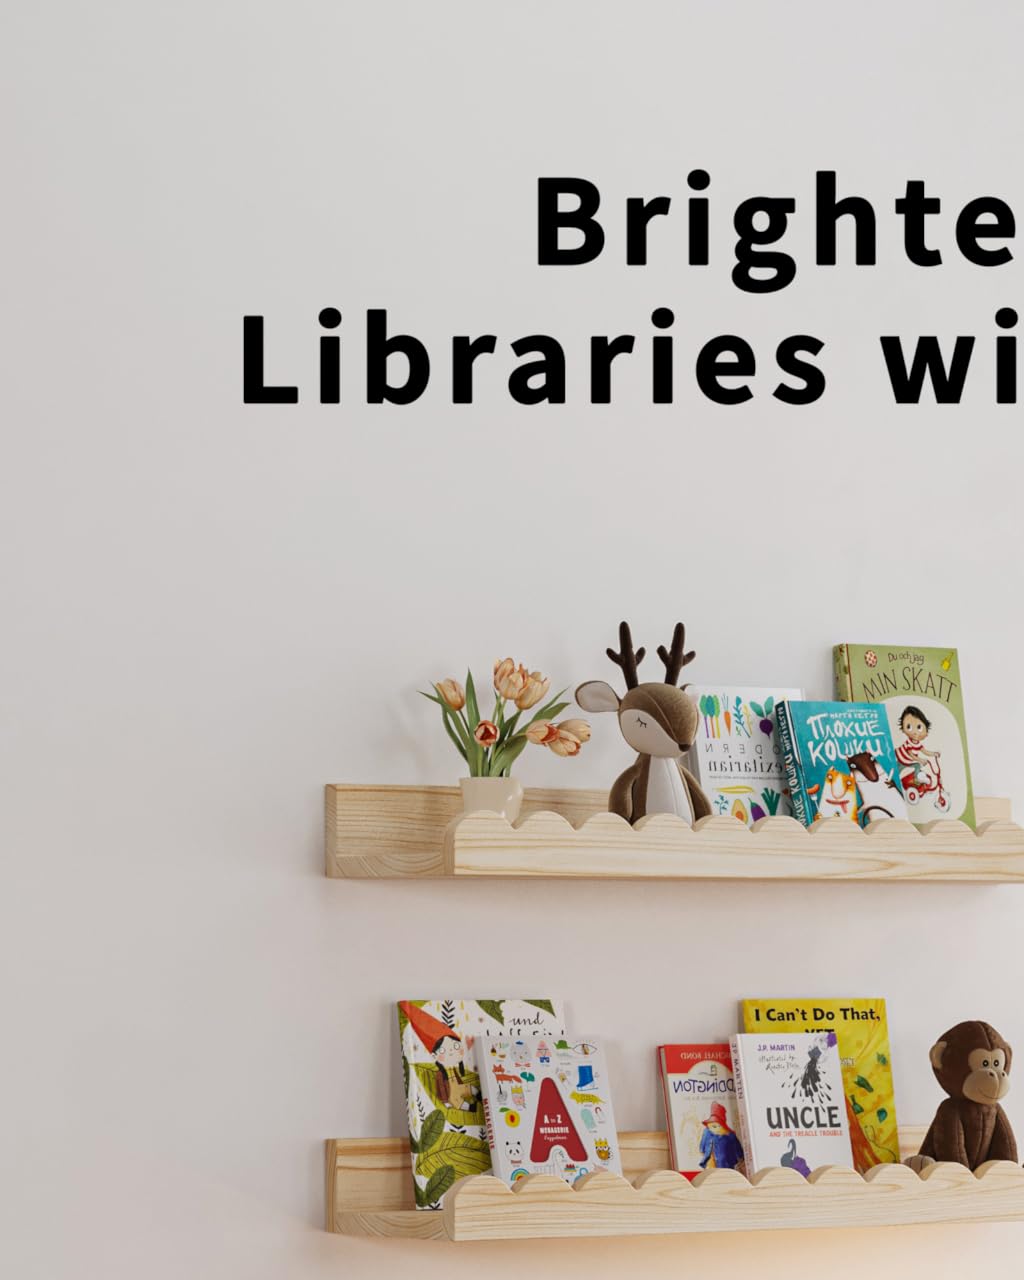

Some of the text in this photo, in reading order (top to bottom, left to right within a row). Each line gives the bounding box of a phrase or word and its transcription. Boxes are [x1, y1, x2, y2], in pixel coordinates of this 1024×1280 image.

[862, 666, 958, 703] MIN SKATT
[510, 1011, 544, 1026] und
[755, 1007, 881, 1022] I Can't Do That,
[544, 1114, 550, 1124] A
[766, 1106, 841, 1129] UNCLE
